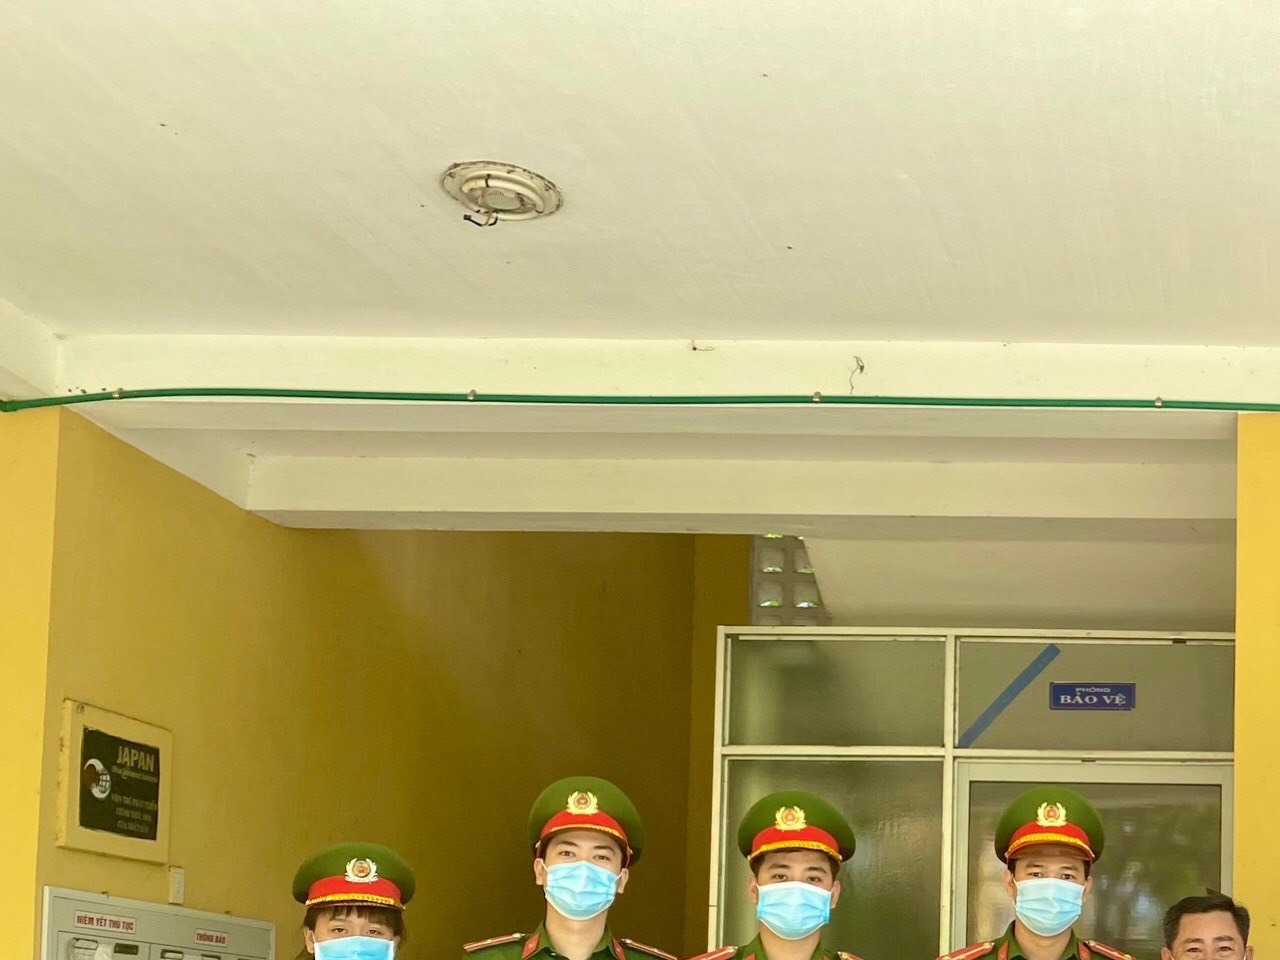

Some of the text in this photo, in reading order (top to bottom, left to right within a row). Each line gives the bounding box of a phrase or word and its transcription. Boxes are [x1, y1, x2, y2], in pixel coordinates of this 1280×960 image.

[1060, 692, 1126, 705] BẢO VỆ
[117, 746, 154, 772] JAPAN
